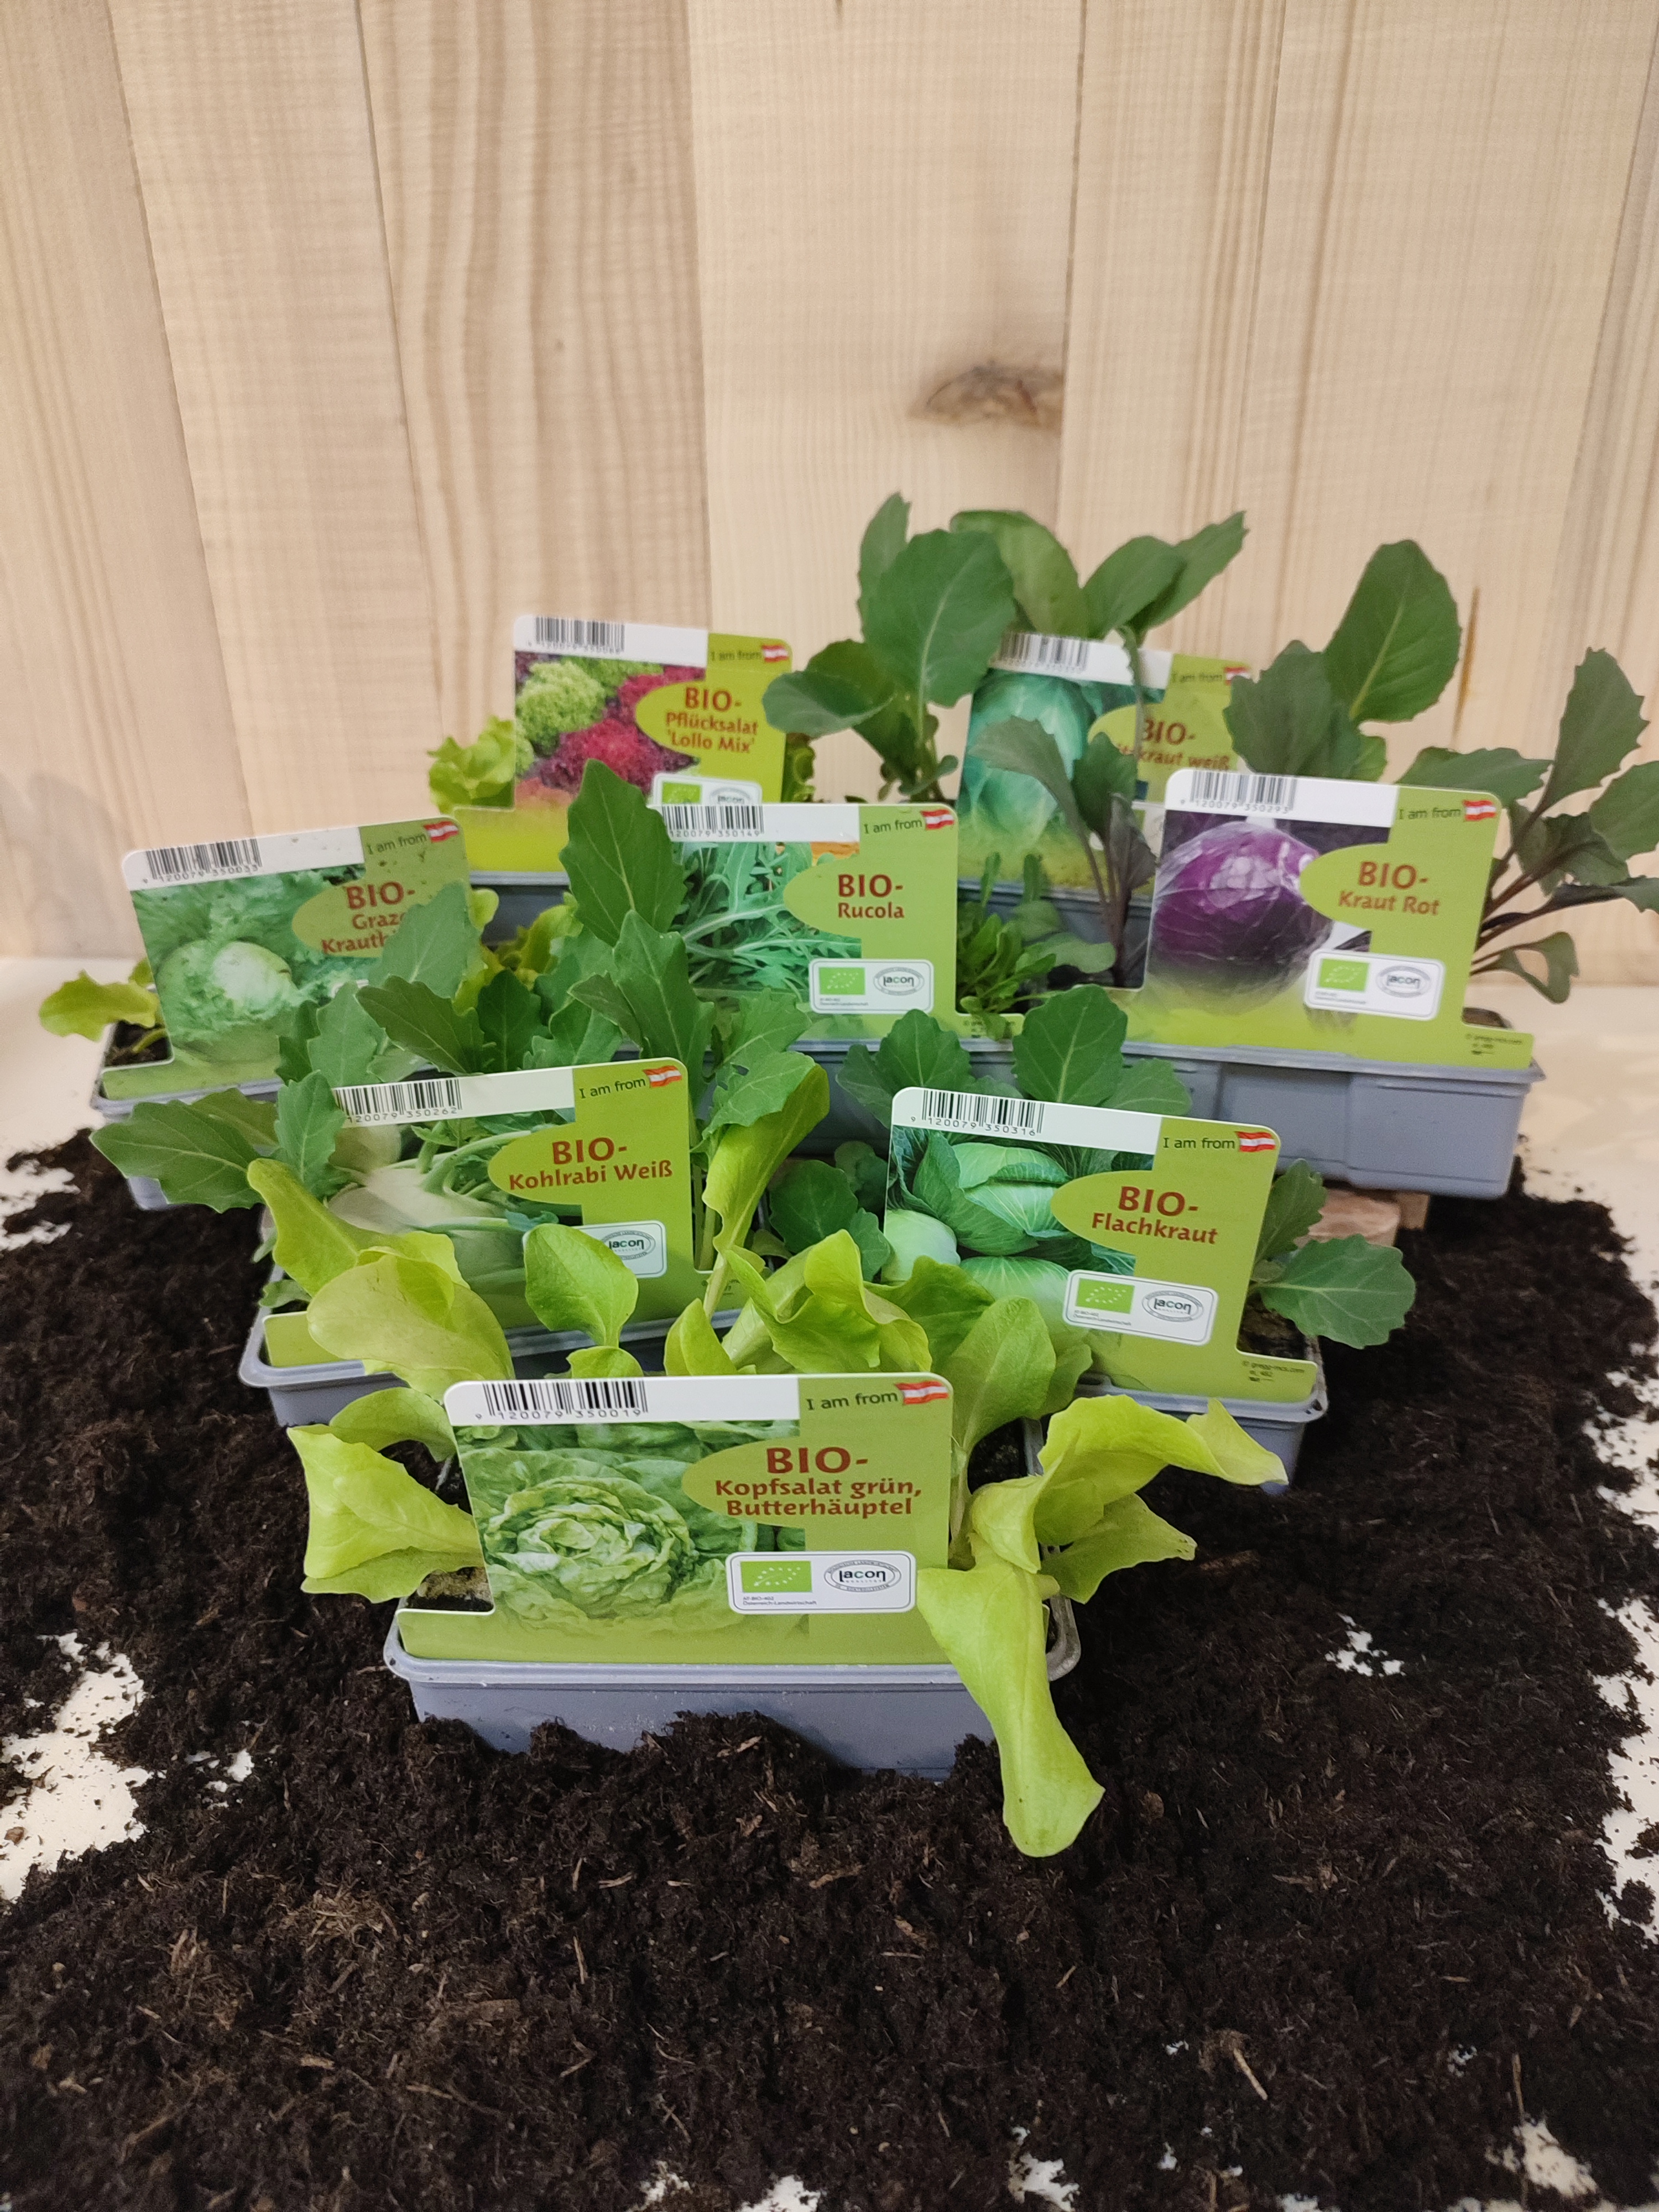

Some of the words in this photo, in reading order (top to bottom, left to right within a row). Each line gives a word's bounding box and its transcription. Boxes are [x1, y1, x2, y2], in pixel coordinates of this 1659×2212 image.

[719, 653, 735, 661] am
[737, 651, 761, 660] from
[685, 687, 742, 712] BIO-
[667, 712, 758, 735] Pflücksalat
[1399, 808, 1404, 820] I
[1408, 809, 1427, 820] am
[1432, 807, 1461, 818] from
[864, 823, 869, 834] I
[873, 823, 891, 833] am
[895, 819, 922, 830] from
[367, 844, 373, 855] I
[377, 840, 396, 853] am
[398, 833, 427, 847] from
[838, 874, 904, 898] BIO-
[1359, 861, 1428, 890] BIO-
[346, 881, 415, 910] BIO-
[1338, 890, 1396, 911] Kraut
[1403, 896, 1440, 915] Rot
[838, 901, 905, 918] Rucola
[579, 1088, 586, 1099] I
[590, 1085, 611, 1097] am
[614, 1078, 646, 1092] from
[347, 1112, 398, 1123] 120079
[406, 1107, 457, 1118] 350262
[928, 1118, 977, 1129] 120079
[985, 1124, 1035, 1136] 350316
[552, 1137, 627, 1165] BIO-
[1163, 1137, 1169, 1148] I
[1174, 1139, 1196, 1149] am
[1202, 1138, 1235, 1149] from
[509, 1165, 607, 1191] Kohlrabi
[613, 1159, 673, 1181] Weiß
[1118, 1186, 1199, 1217] BIO-
[1092, 1212, 1218, 1244] Flachkraut
[807, 1399, 815, 1411] I
[821, 1396, 849, 1409] am
[855, 1391, 898, 1406] from
[498, 1411, 564, 1420] 120079
[575, 1410, 641, 1418] 350019
[766, 1447, 869, 1474] BIO-
[716, 1477, 843, 1500] Kopfsalat
[850, 1477, 922, 1500] grün,
[727, 1497, 912, 1519] Butterhäuptel
